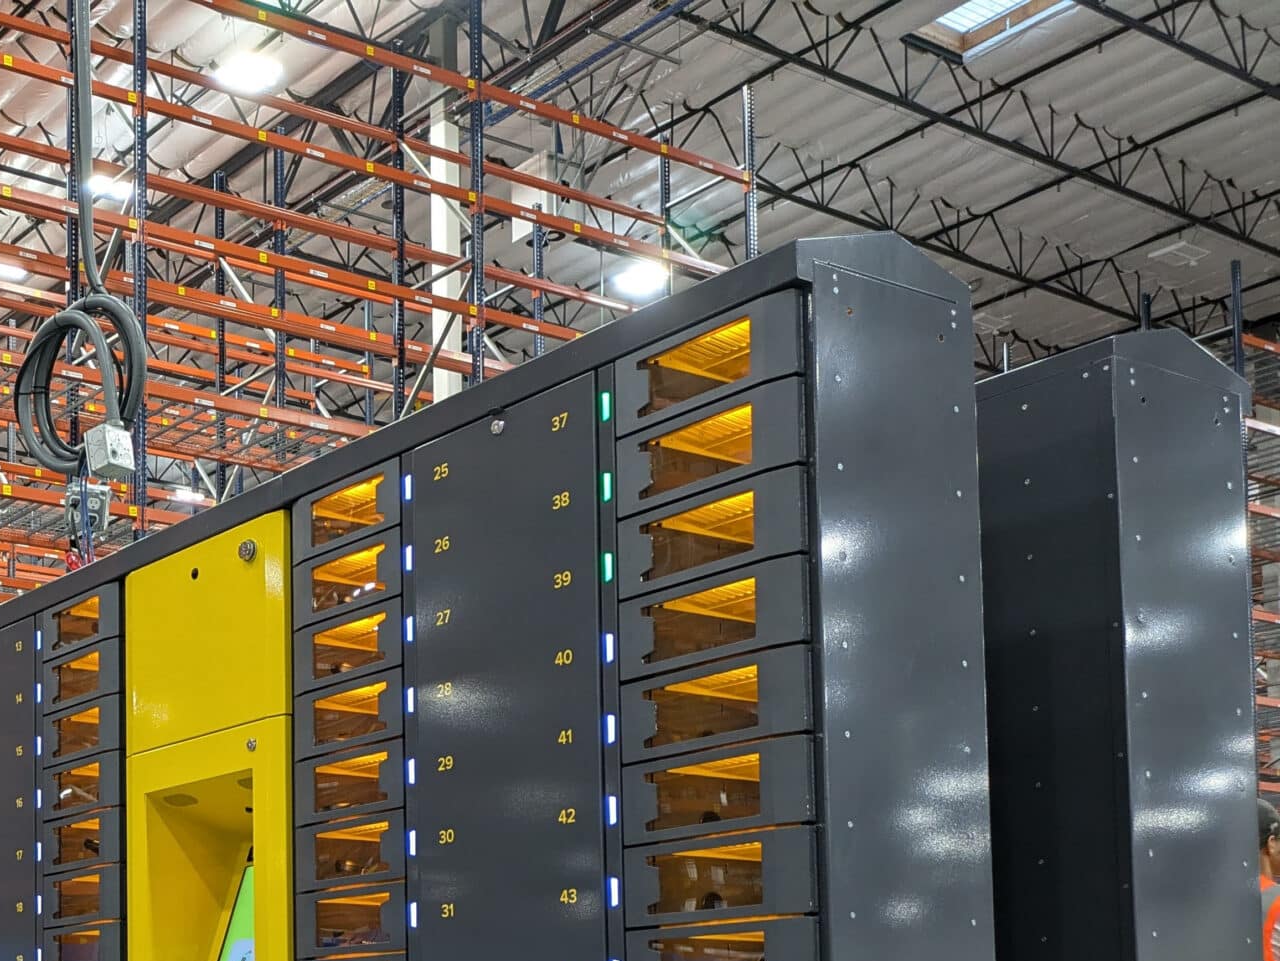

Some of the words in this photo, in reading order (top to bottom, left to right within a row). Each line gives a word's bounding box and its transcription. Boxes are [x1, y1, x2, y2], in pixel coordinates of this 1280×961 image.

[551, 412, 569, 432] 37
[433, 463, 449, 481] 25
[552, 490, 570, 511] 38
[434, 536, 451, 554] 26
[553, 570, 572, 589] 39
[435, 608, 451, 626] 27
[15, 641, 23, 652] 13
[554, 648, 573, 666] 40
[15, 693, 23, 704] 14
[436, 682, 452, 698] 28
[557, 729, 573, 745] 41
[16, 745, 24, 756] 15
[437, 755, 454, 772] 29
[16, 797, 23, 808] 16
[558, 807, 576, 825] 42
[438, 828, 455, 845] 30
[16, 849, 24, 860] 17
[560, 887, 577, 904] 43
[441, 903, 455, 919] 31
